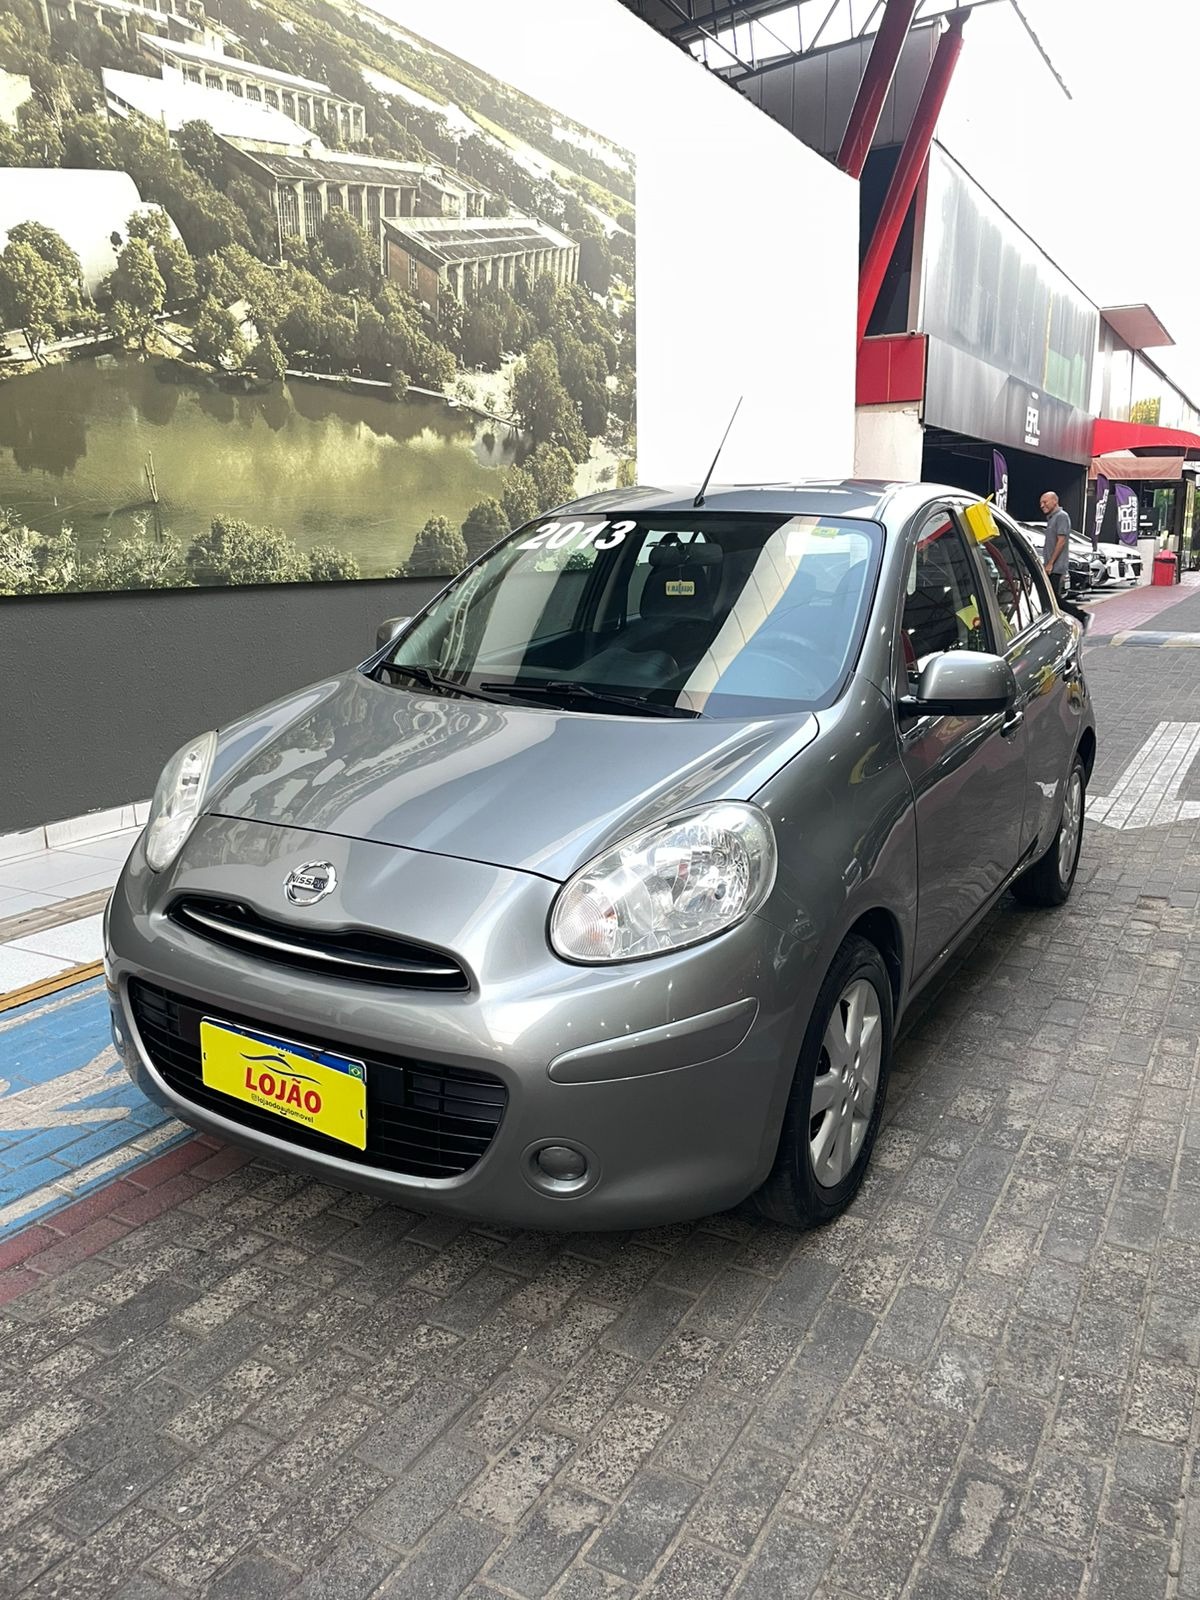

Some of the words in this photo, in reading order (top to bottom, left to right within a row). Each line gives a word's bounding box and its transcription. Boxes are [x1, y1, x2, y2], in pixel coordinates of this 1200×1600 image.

[515, 520, 637, 550] 2013
[289, 873, 326, 890] NISSAN
[245, 1067, 322, 1114] LOJÃO
